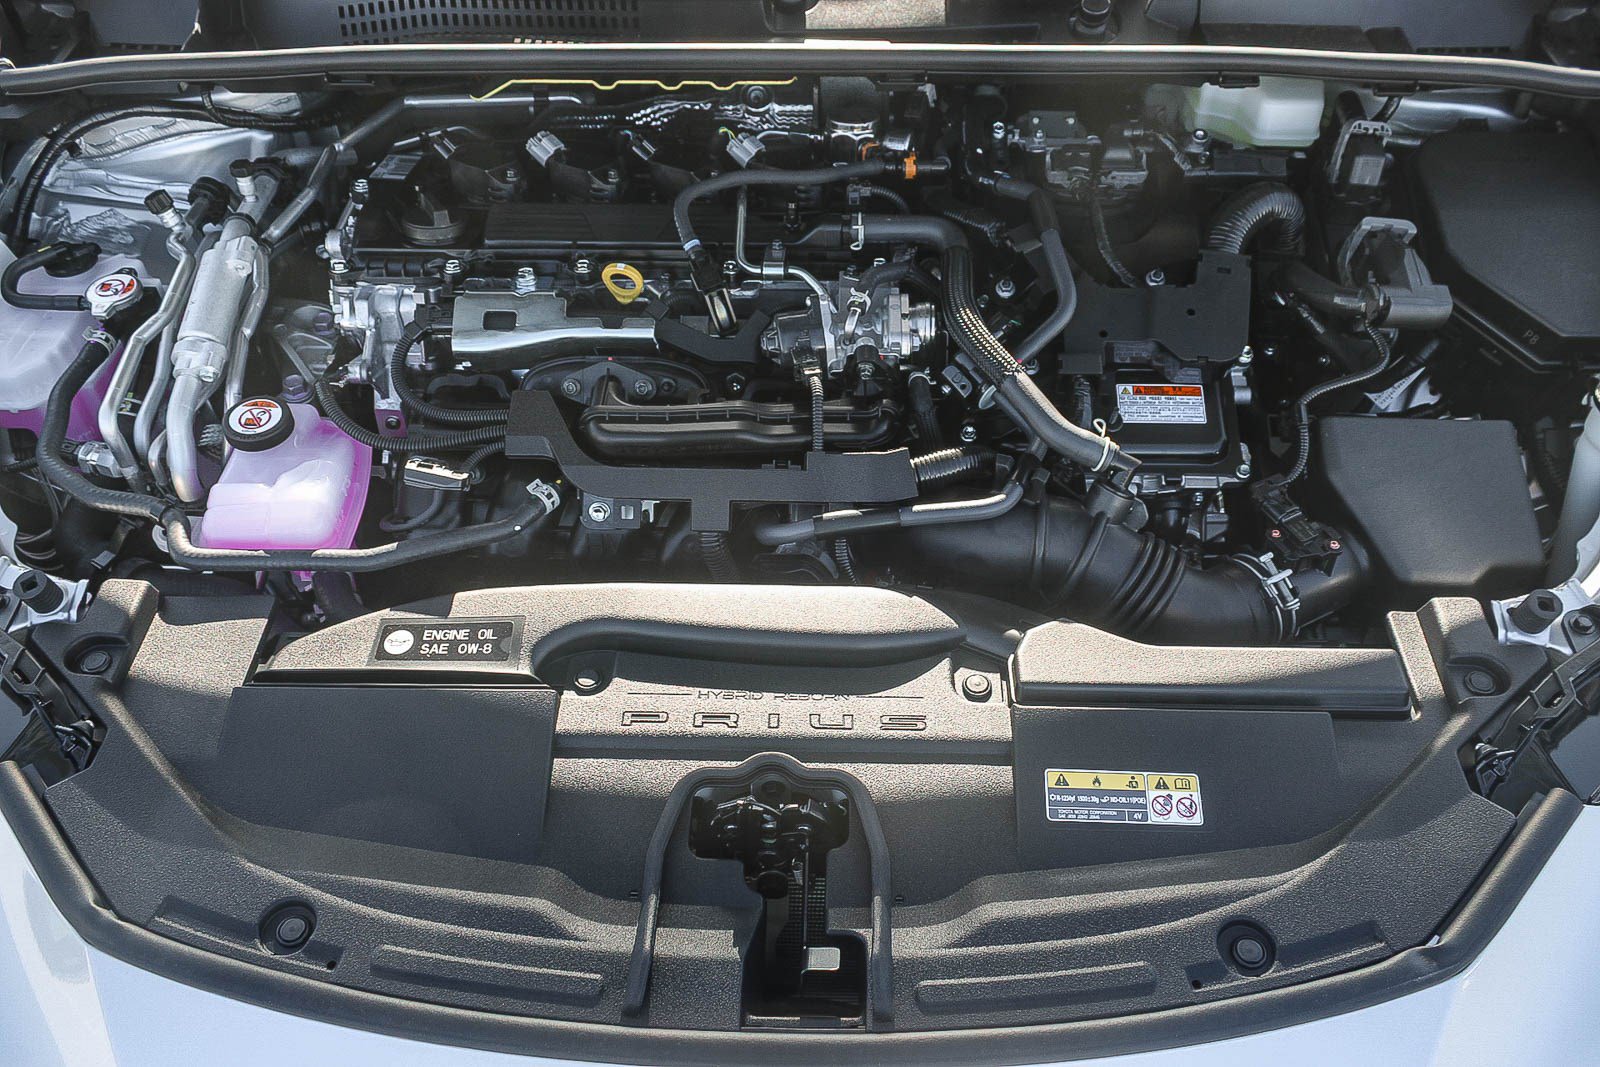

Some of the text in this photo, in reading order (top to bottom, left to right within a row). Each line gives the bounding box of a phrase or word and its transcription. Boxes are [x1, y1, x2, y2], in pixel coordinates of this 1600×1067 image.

[422, 629, 498, 640] ENGINE OIL
[420, 643, 493, 654] SAE 0W-8
[697, 690, 764, 701] HYBRID
[621, 711, 927, 731] PRIUS
